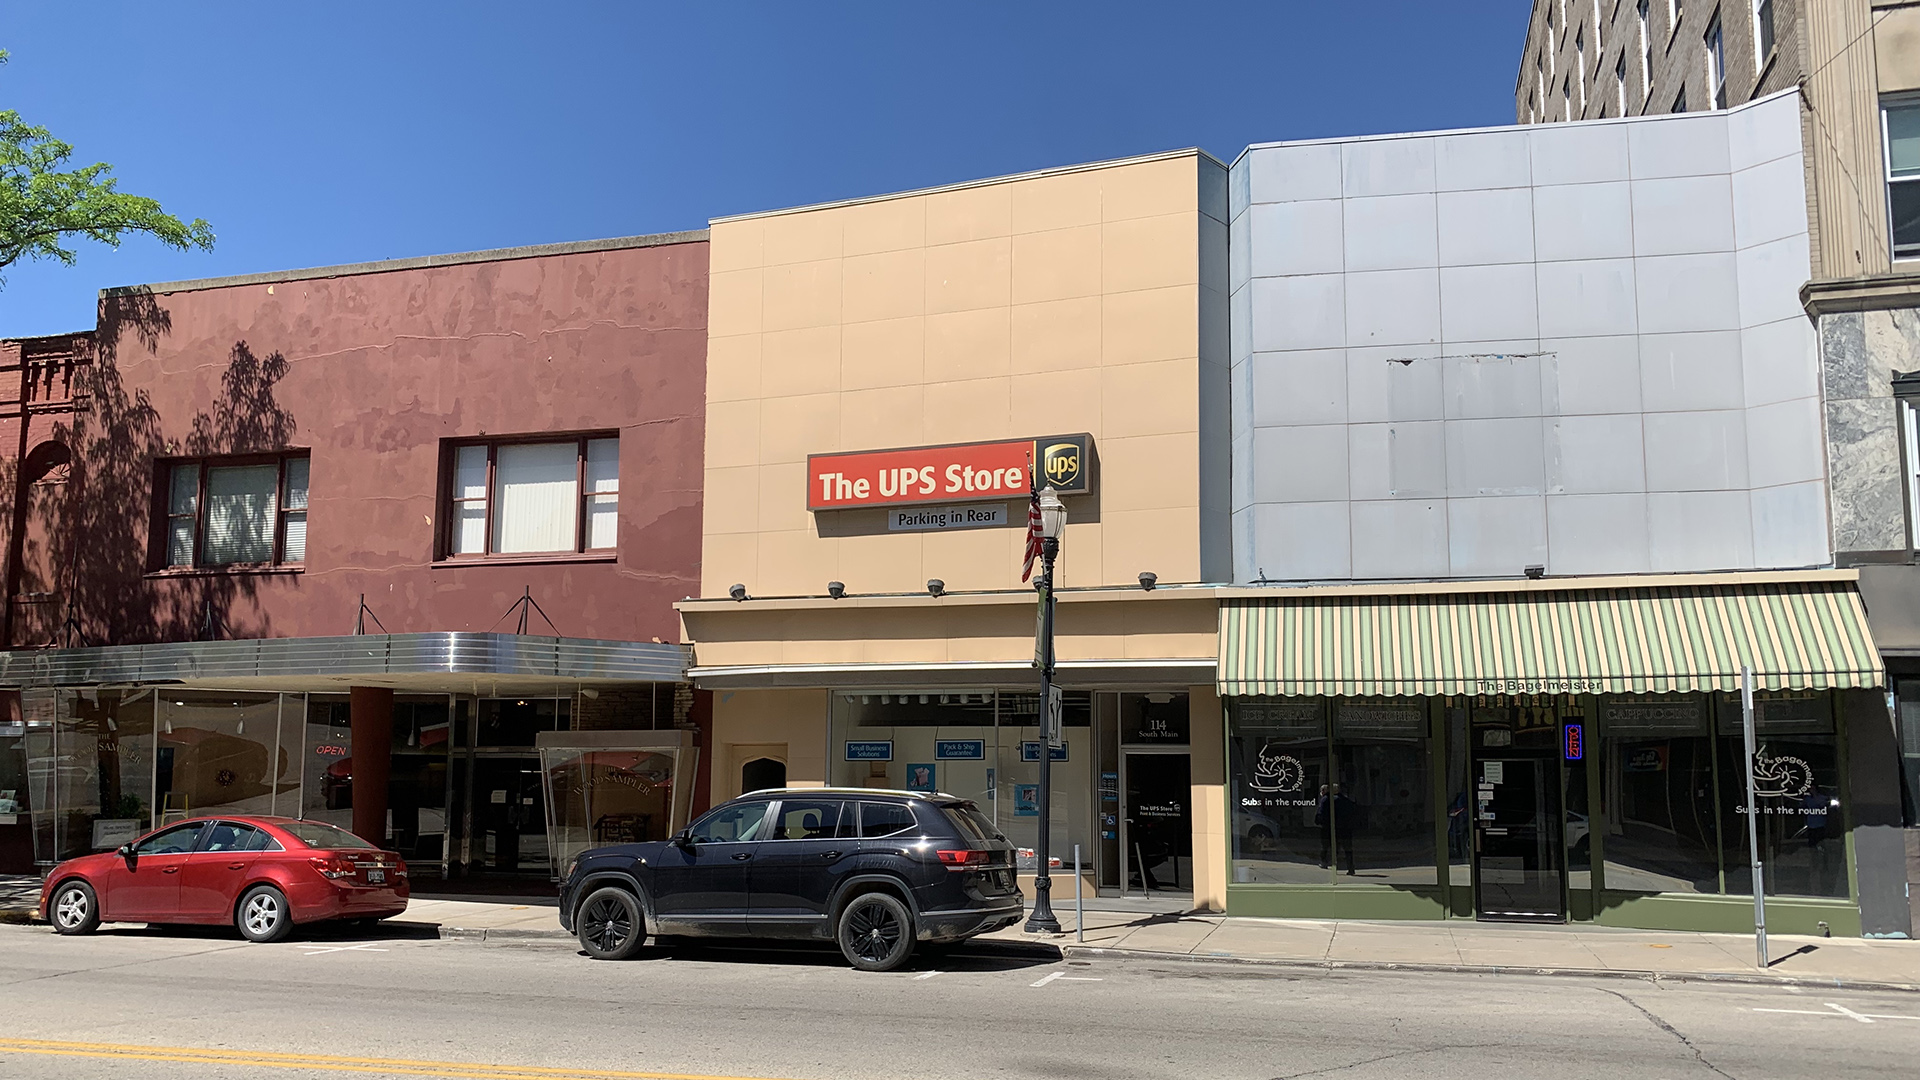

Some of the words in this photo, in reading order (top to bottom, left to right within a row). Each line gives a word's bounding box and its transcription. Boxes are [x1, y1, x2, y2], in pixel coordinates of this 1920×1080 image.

[1047, 455, 1077, 480] ups
[819, 472, 870, 501] The
[879, 465, 936, 497] UPS
[945, 463, 1022, 493] Store
[898, 511, 946, 527] Parking
[951, 510, 962, 523] in
[967, 509, 996, 522] Rear
[1477, 681, 1503, 691] The
[1507, 680, 1602, 692] Bagelmeister
[1242, 709, 1264, 721] ICE
[1267, 709, 1315, 721] CREAM
[1339, 709, 1422, 722] SANDWICHES
[1605, 708, 1700, 720] CAPPUCCINO
[1150, 719, 1167, 731] 114
[98, 733, 111, 741] THE
[1138, 730, 1158, 738] South
[1160, 730, 1179, 738] Main
[943, 743, 957, 751] Pack
[957, 743, 963, 751] &
[963, 743, 975, 752] Ship
[1568, 726, 1580, 757] OPEN
[316, 745, 347, 756] OPEN
[866, 744, 888, 752] Business
[1274, 755, 1306, 791] Bagelmeister
[1774, 755, 1815, 795] Bagelmeister
[605, 774, 651, 797] SAMPLER
[1241, 797, 1262, 806] Subs
[1264, 797, 1273, 806] in
[1275, 797, 1290, 806] the
[1292, 797, 1316, 806] round
[1735, 805, 1760, 814] Sus
[1763, 805, 1773, 814] in
[1776, 805, 1794, 815] the
[1798, 806, 1828, 815] round
